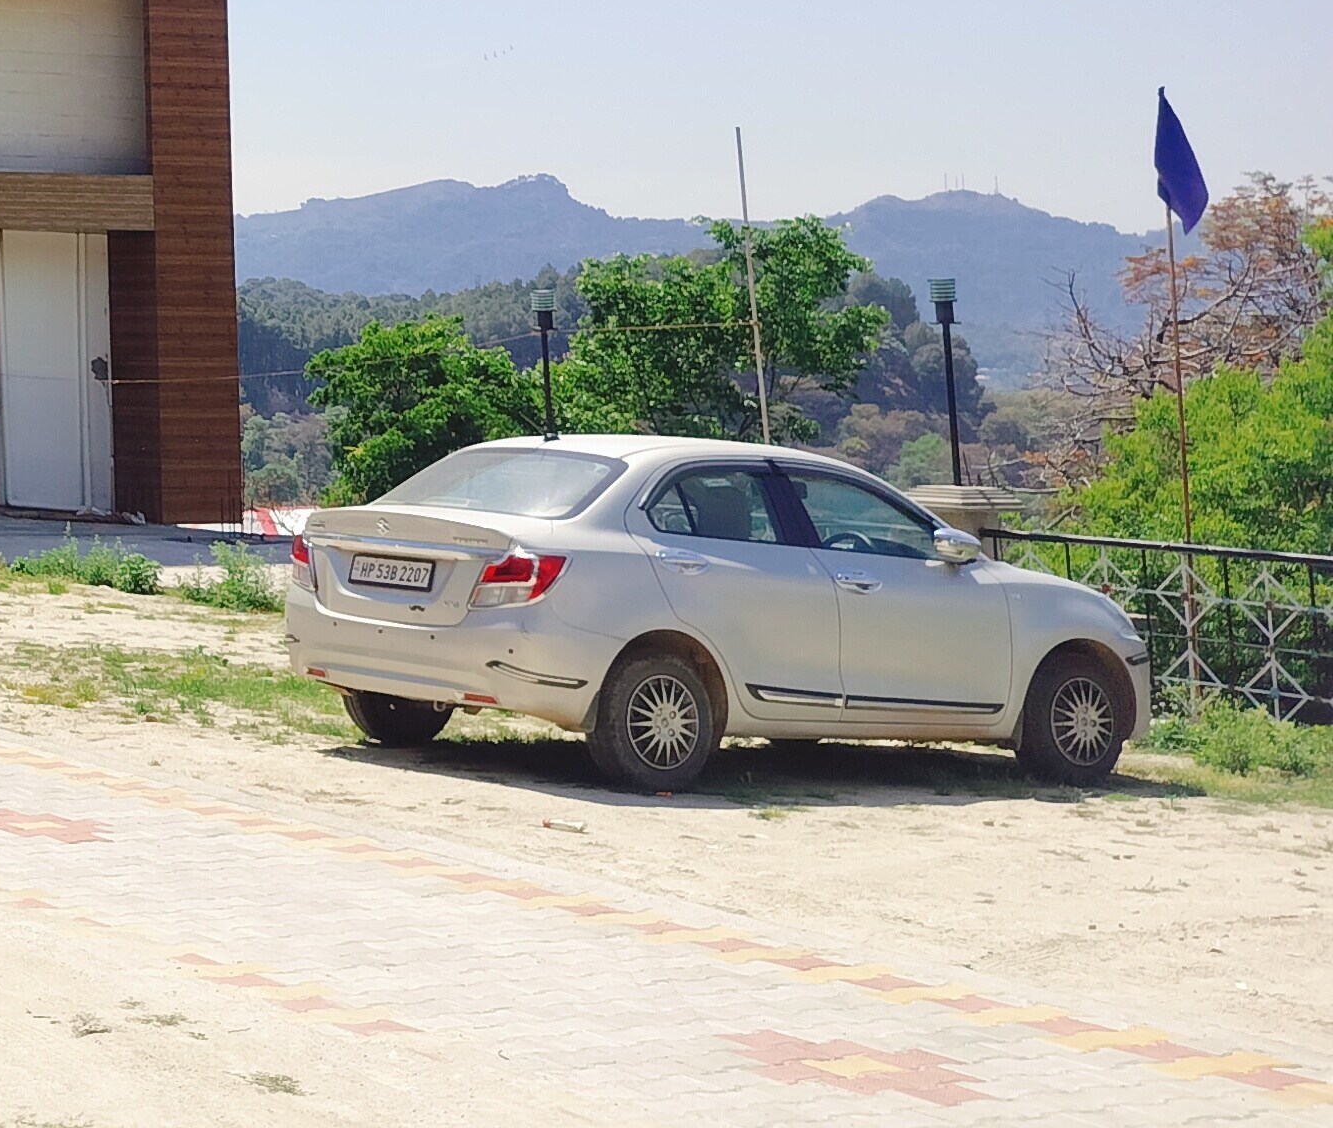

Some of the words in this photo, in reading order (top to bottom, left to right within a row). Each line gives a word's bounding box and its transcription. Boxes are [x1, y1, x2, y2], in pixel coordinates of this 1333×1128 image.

[359, 562, 376, 578] HP
[376, 563, 398, 581] 53B
[398, 565, 429, 583] 2207
